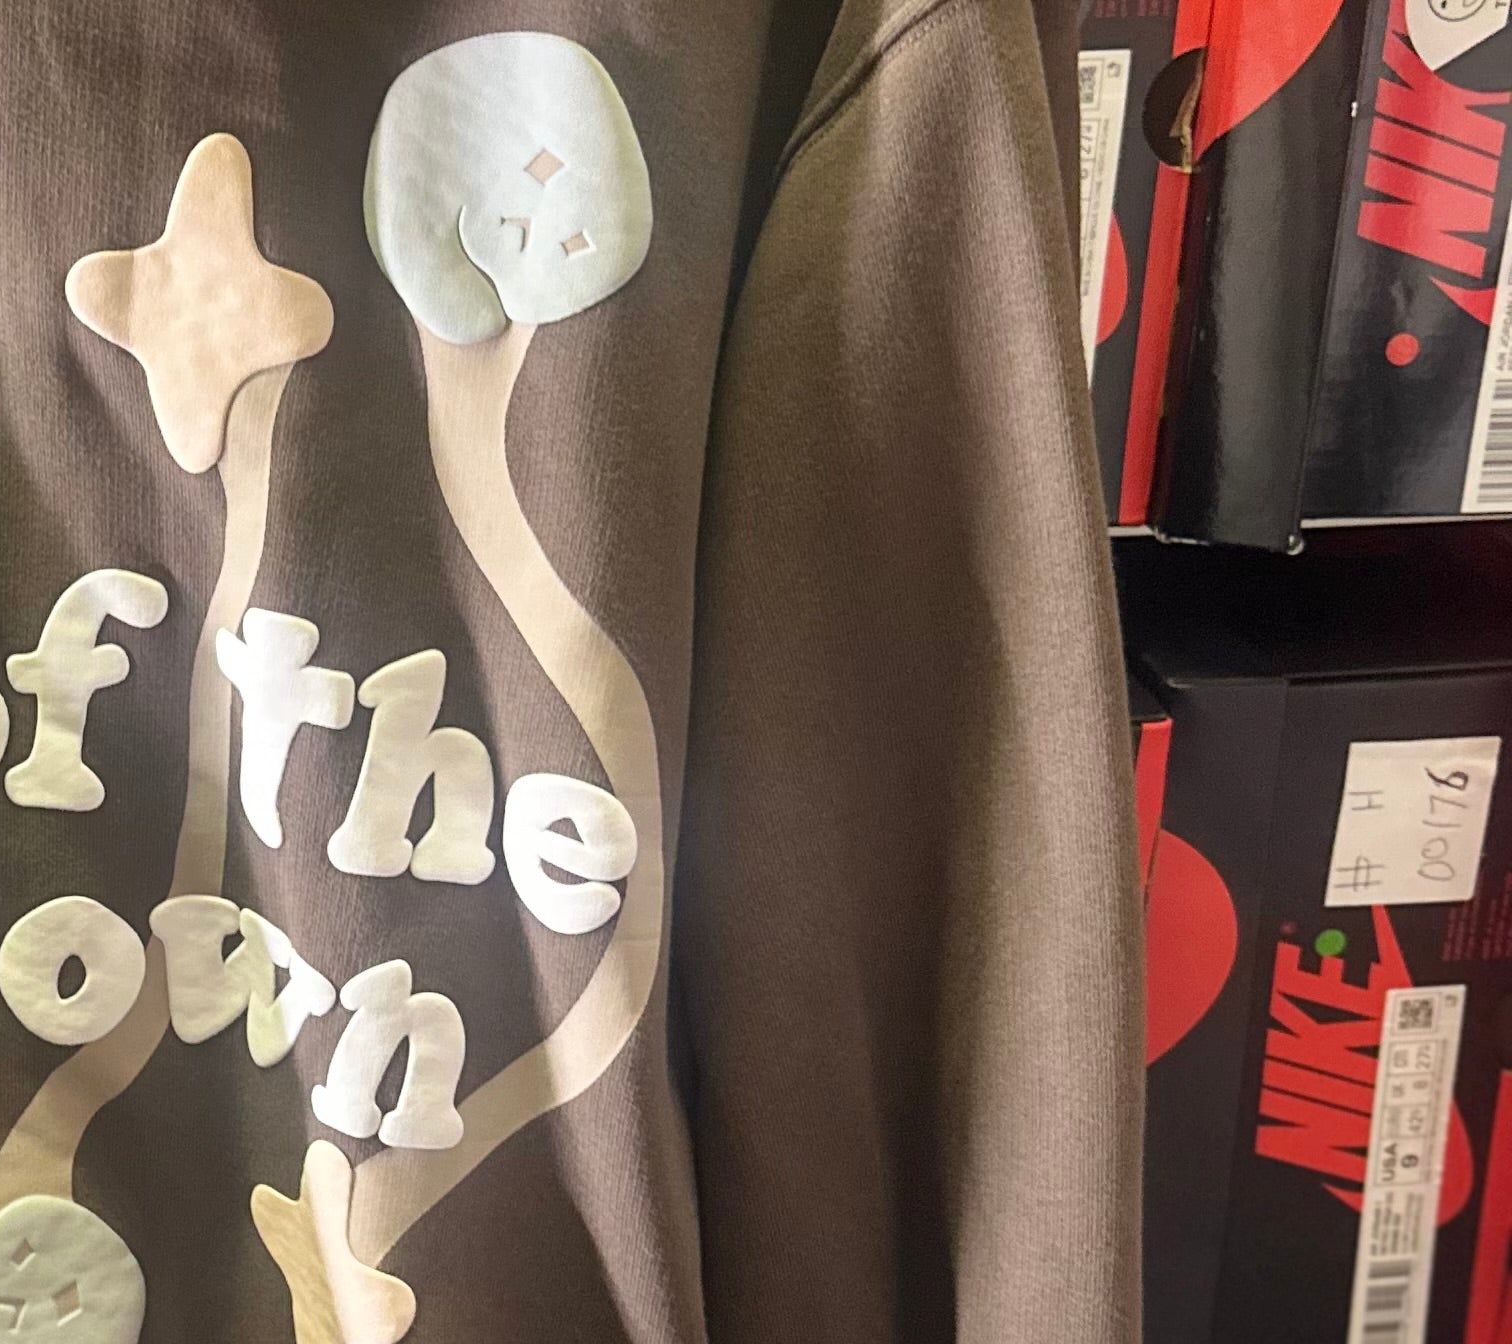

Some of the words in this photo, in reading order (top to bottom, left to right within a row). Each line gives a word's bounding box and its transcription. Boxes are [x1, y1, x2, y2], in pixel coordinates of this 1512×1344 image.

[216, 607, 638, 935] the
[1255, 942, 1388, 1181] NIKE
[1381, 1143, 1398, 1182] USA
